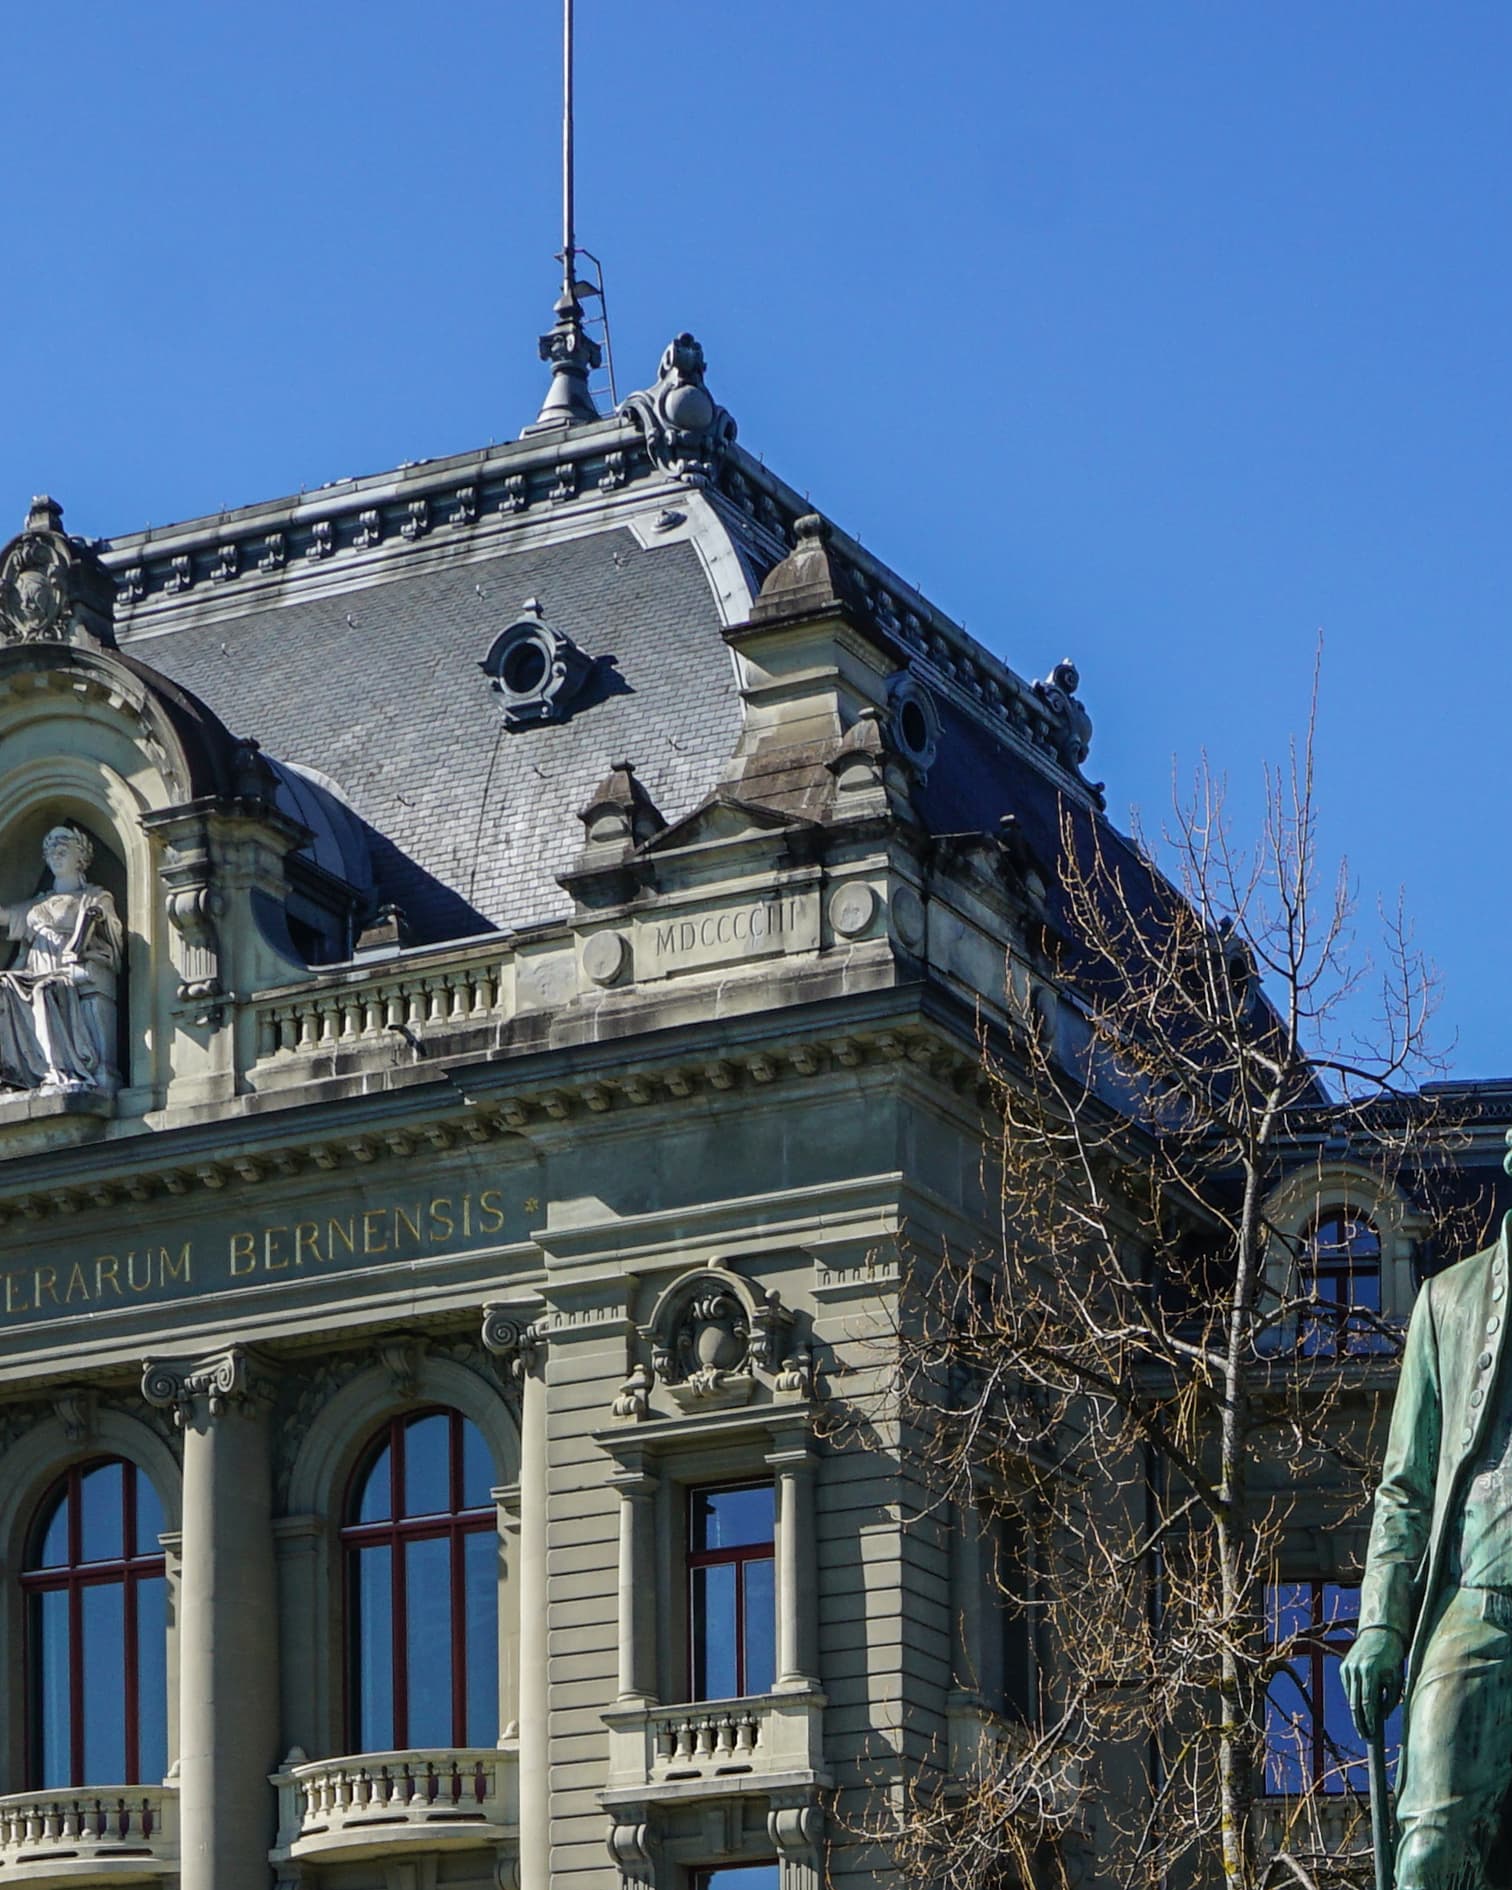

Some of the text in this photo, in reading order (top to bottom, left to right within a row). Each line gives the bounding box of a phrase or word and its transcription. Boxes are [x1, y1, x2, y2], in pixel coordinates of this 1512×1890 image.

[656, 899, 797, 955] MDCCCCIII
[0, 1191, 504, 1312] ERARUM BERNENSIS
